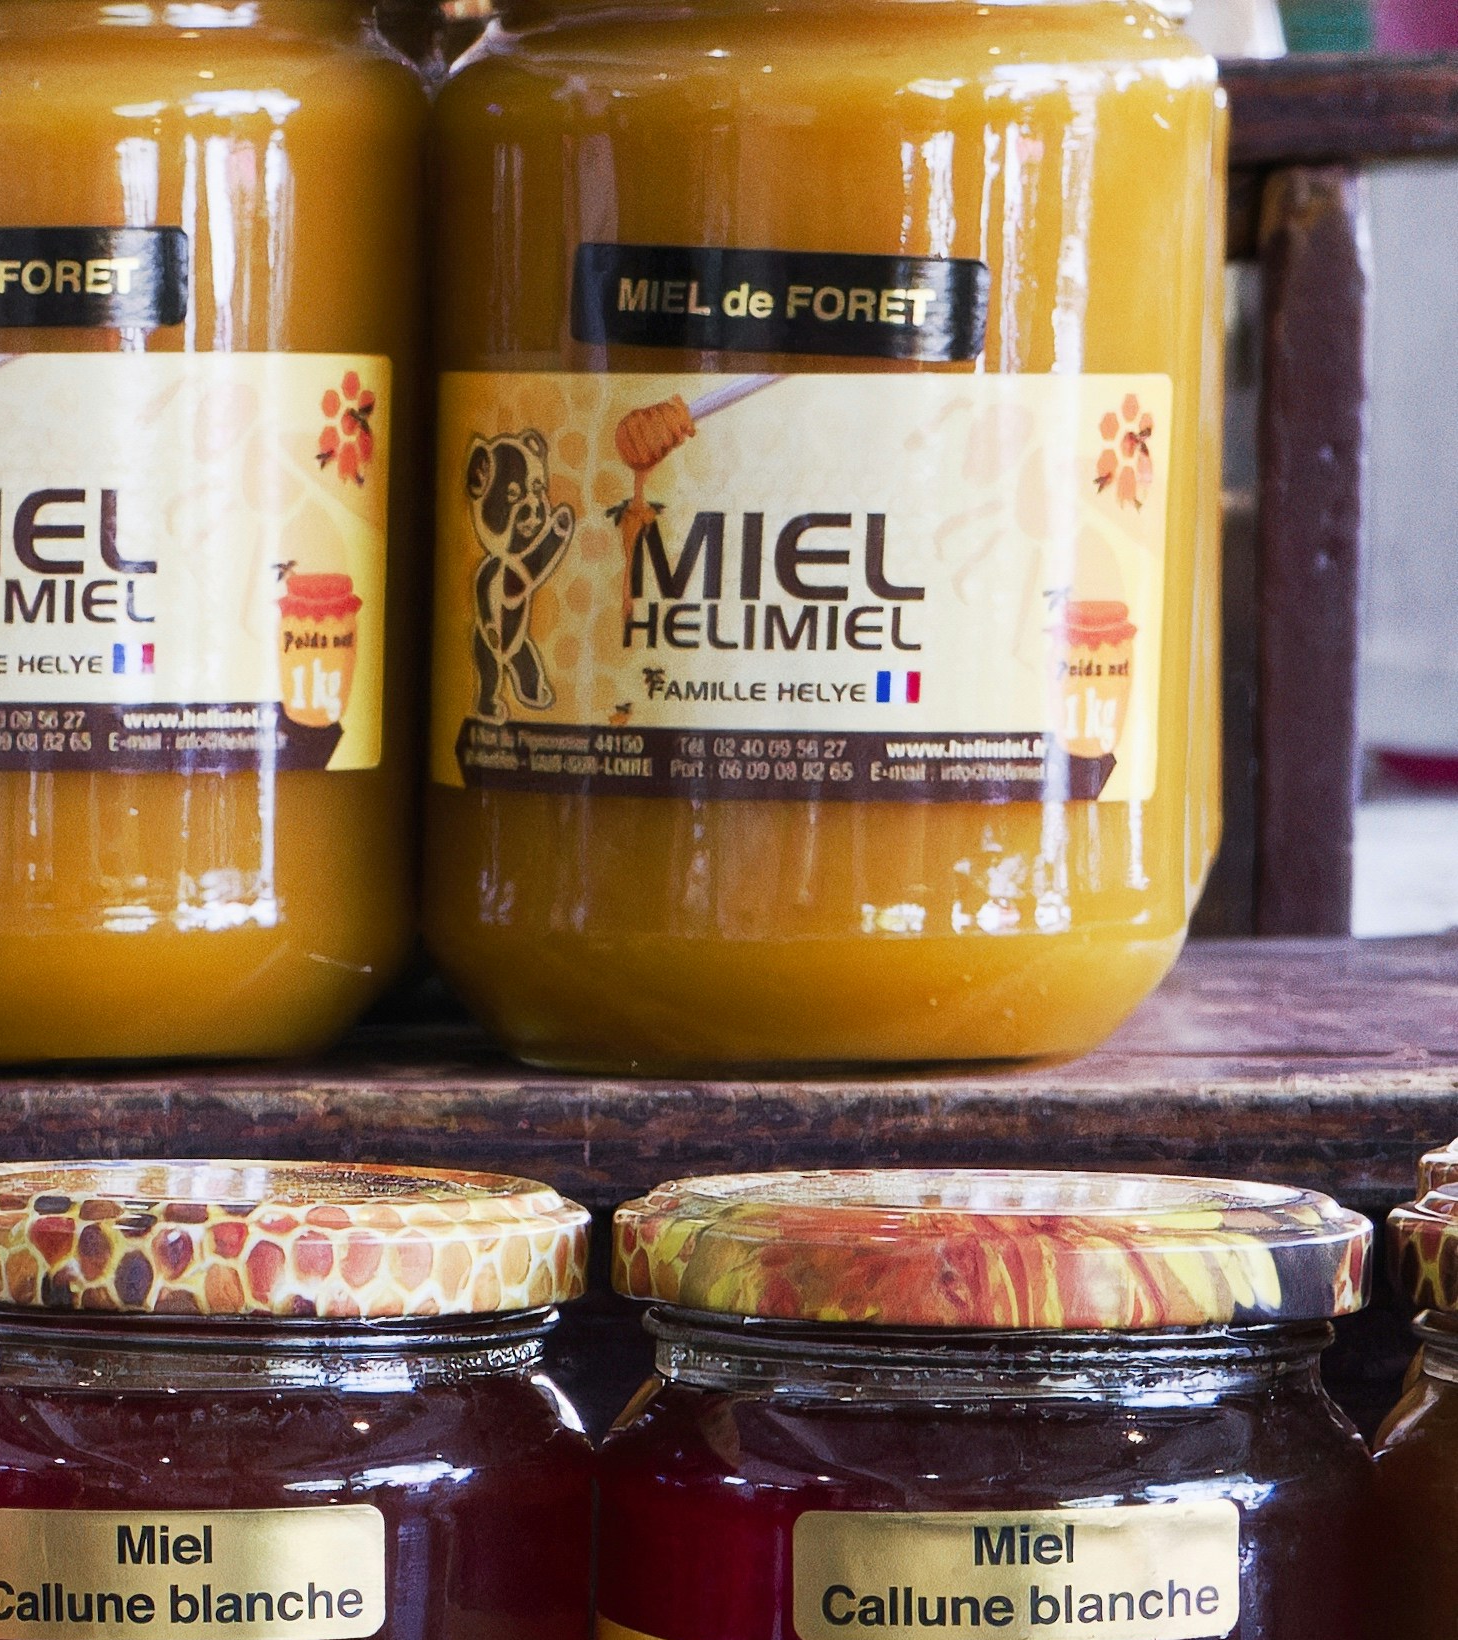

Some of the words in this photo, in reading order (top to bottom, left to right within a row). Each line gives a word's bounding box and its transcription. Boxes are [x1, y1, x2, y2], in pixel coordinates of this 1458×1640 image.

[618, 278, 711, 316] MIEL
[723, 283, 774, 317] de
[786, 285, 935, 325] FORET
[632, 512, 925, 601] MIEL
[623, 603, 922, 650] HELIMIEL
[19, 654, 103, 674] HELYE
[648, 680, 767, 702] FAMILLE
[777, 681, 866, 702] HELYE
[117, 1525, 213, 1564] Miel
[973, 1526, 1074, 1566] Miel
[170, 1582, 363, 1623] blanche
[822, 1585, 1015, 1626] Callune
[1030, 1582, 1219, 1626] blanche
